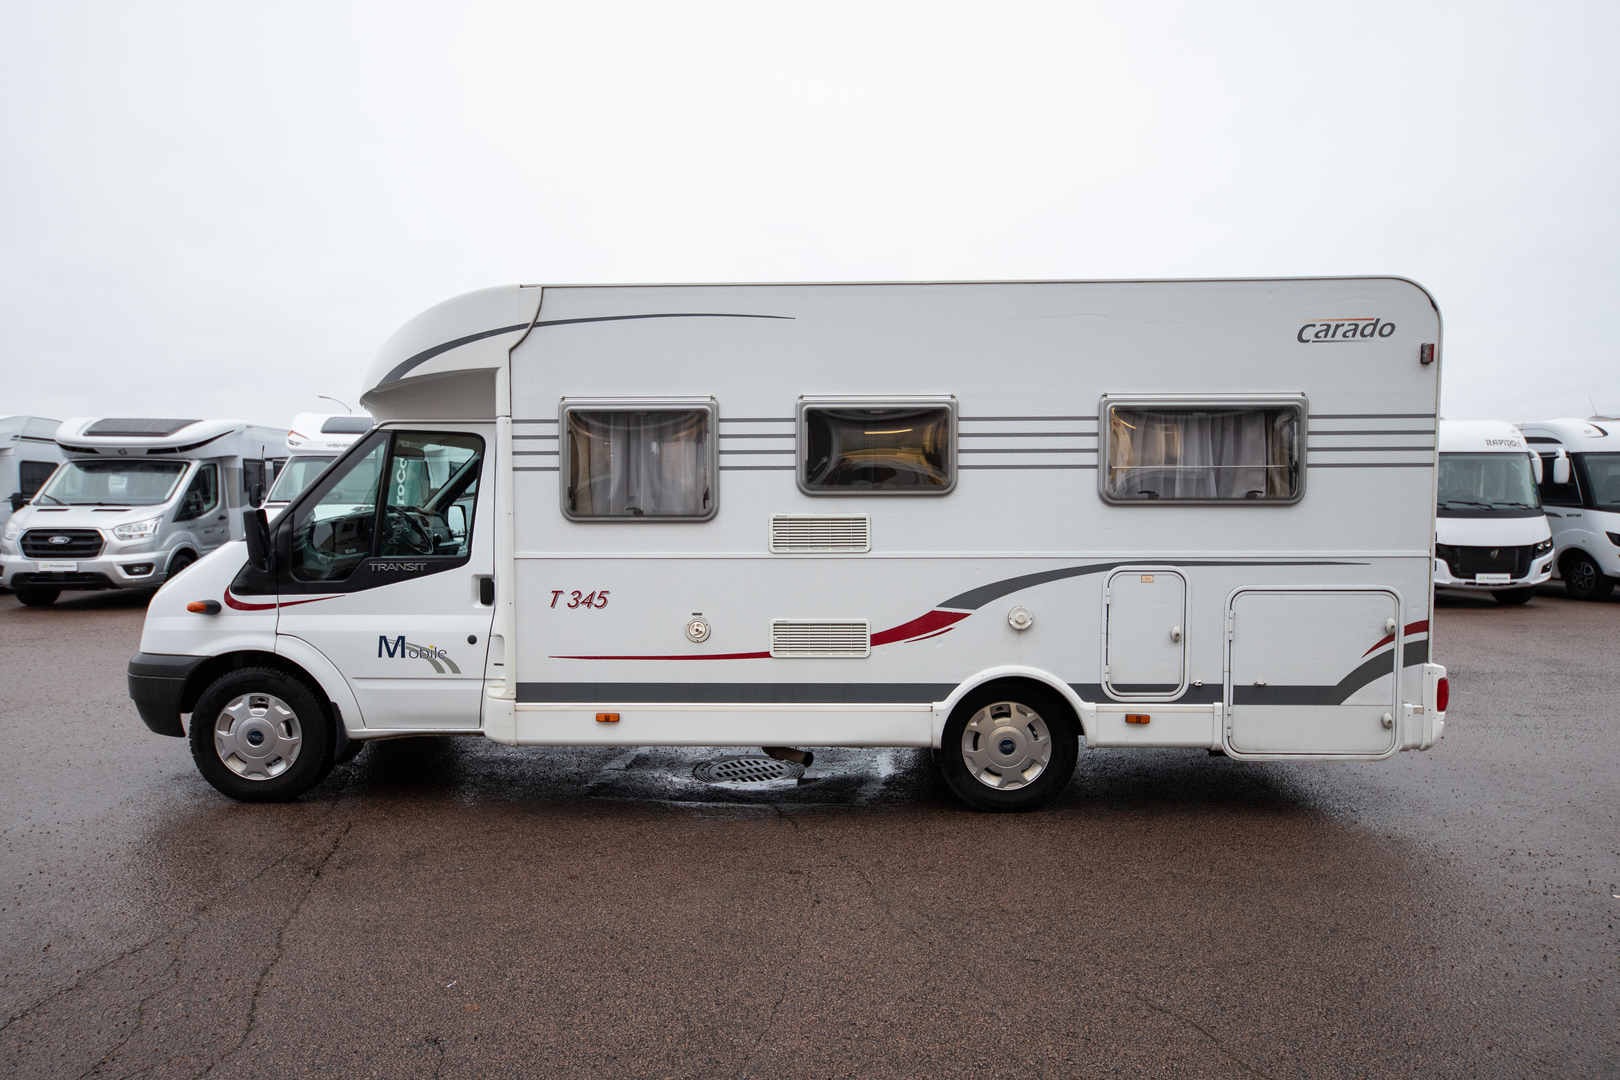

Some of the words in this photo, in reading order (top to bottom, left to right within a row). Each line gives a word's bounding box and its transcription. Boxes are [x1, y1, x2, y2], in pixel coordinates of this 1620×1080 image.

[1297, 317, 1396, 343] carado
[369, 562, 428, 572] TRANSIT
[550, 590, 565, 609] T
[567, 590, 611, 610] 345
[378, 635, 448, 660] Mobile
